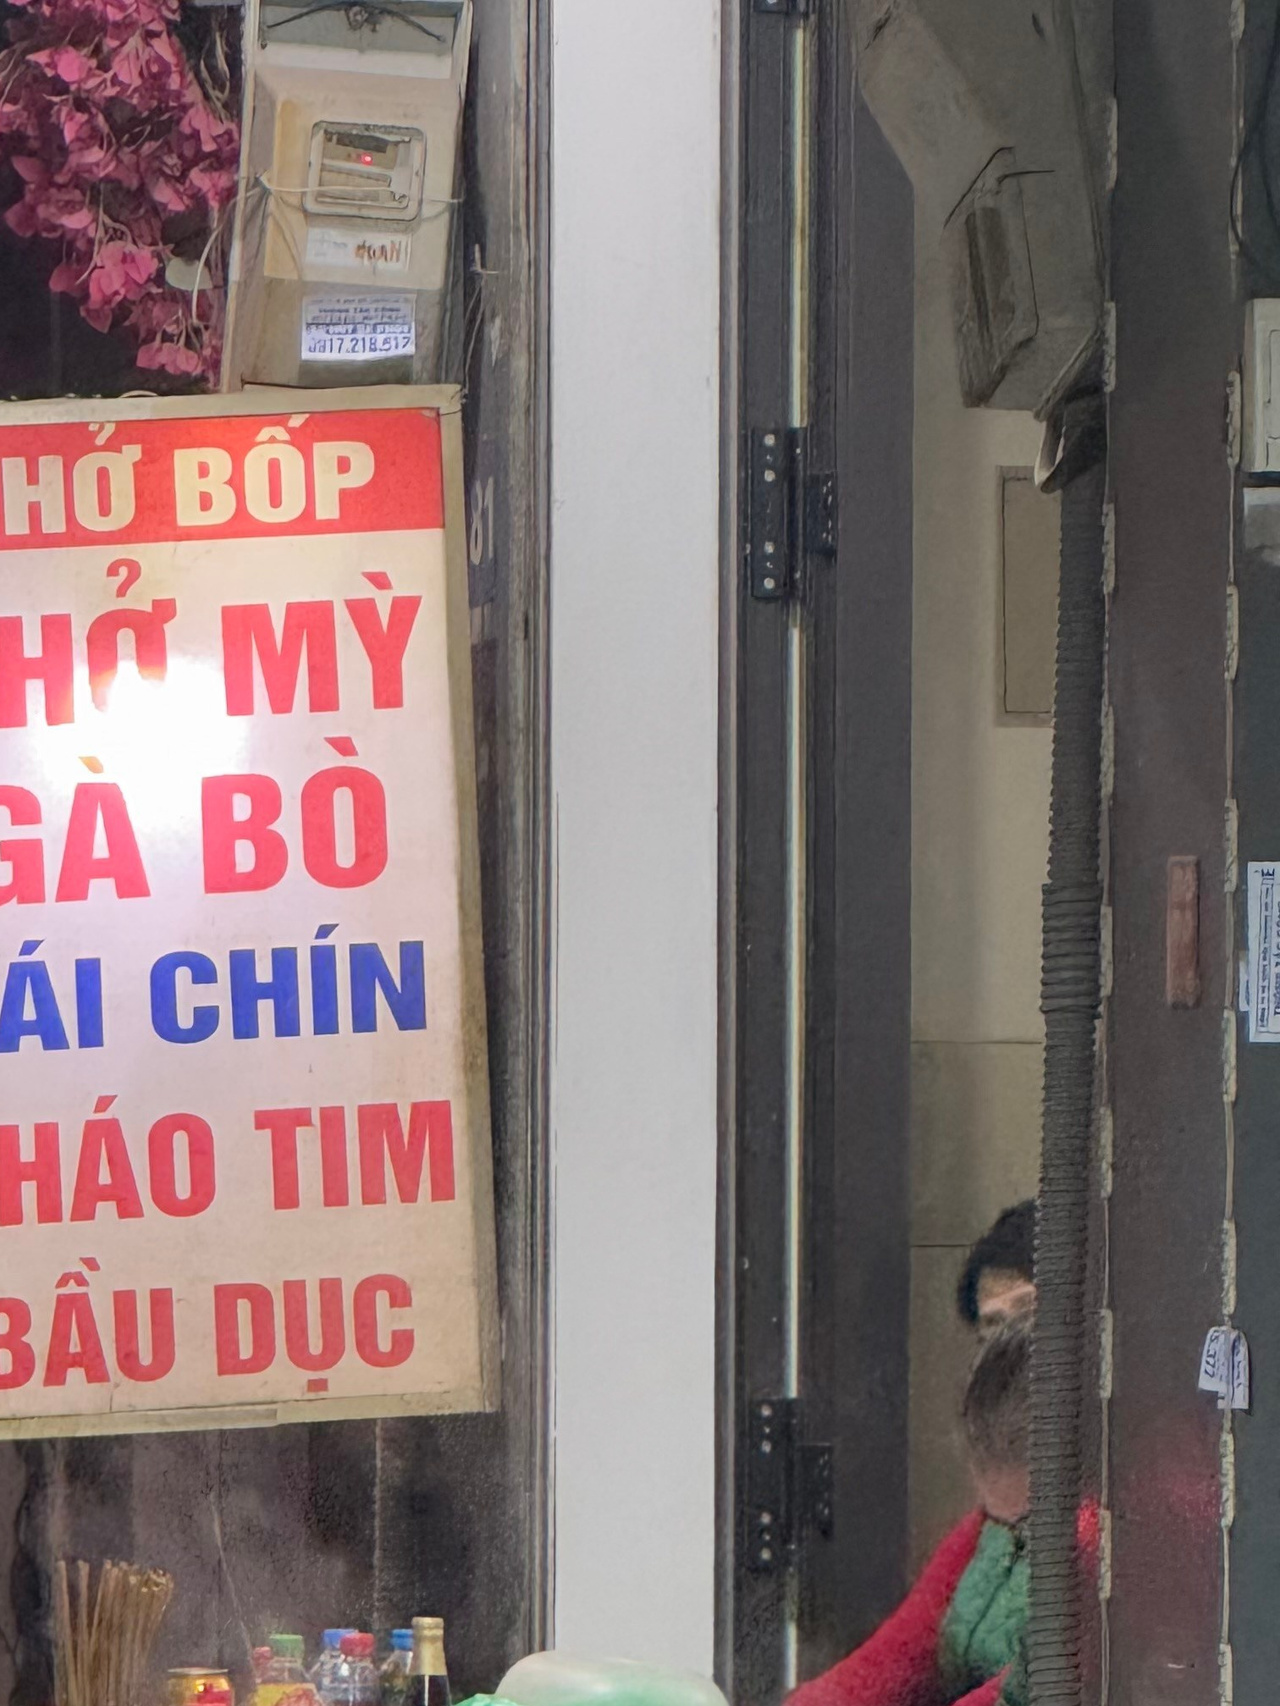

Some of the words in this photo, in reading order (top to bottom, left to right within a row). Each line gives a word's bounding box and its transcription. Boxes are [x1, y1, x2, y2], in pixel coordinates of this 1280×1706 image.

[173, 413, 375, 527] BỐP
[221, 571, 422, 717] MỲ
[201, 736, 389, 895] BÒ
[149, 923, 427, 1044] CHÍN
[254, 1099, 456, 1211] TIM
[213, 1273, 415, 1395] DỤC
